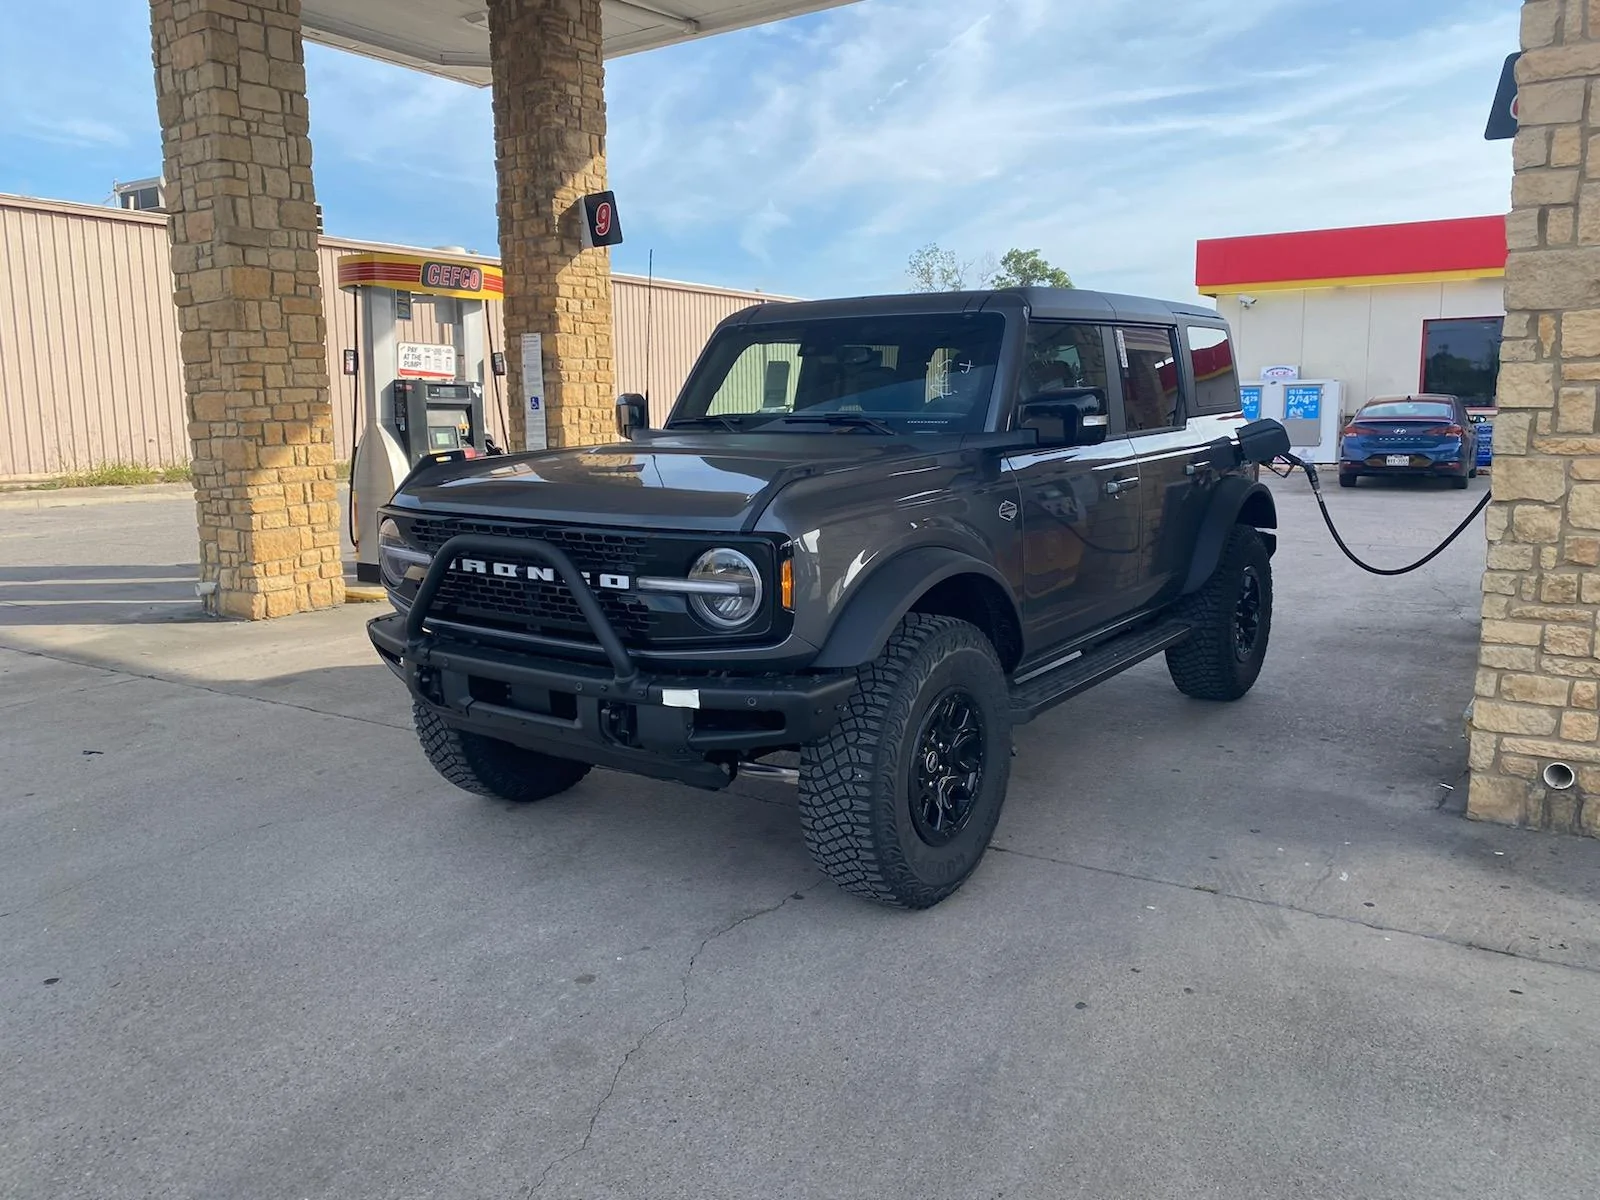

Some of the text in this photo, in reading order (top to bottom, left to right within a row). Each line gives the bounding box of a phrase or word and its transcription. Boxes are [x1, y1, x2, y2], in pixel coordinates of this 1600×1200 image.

[595, 202, 611, 236] 9
[427, 264, 480, 289] CEFCO
[450, 558, 630, 590] RONO
